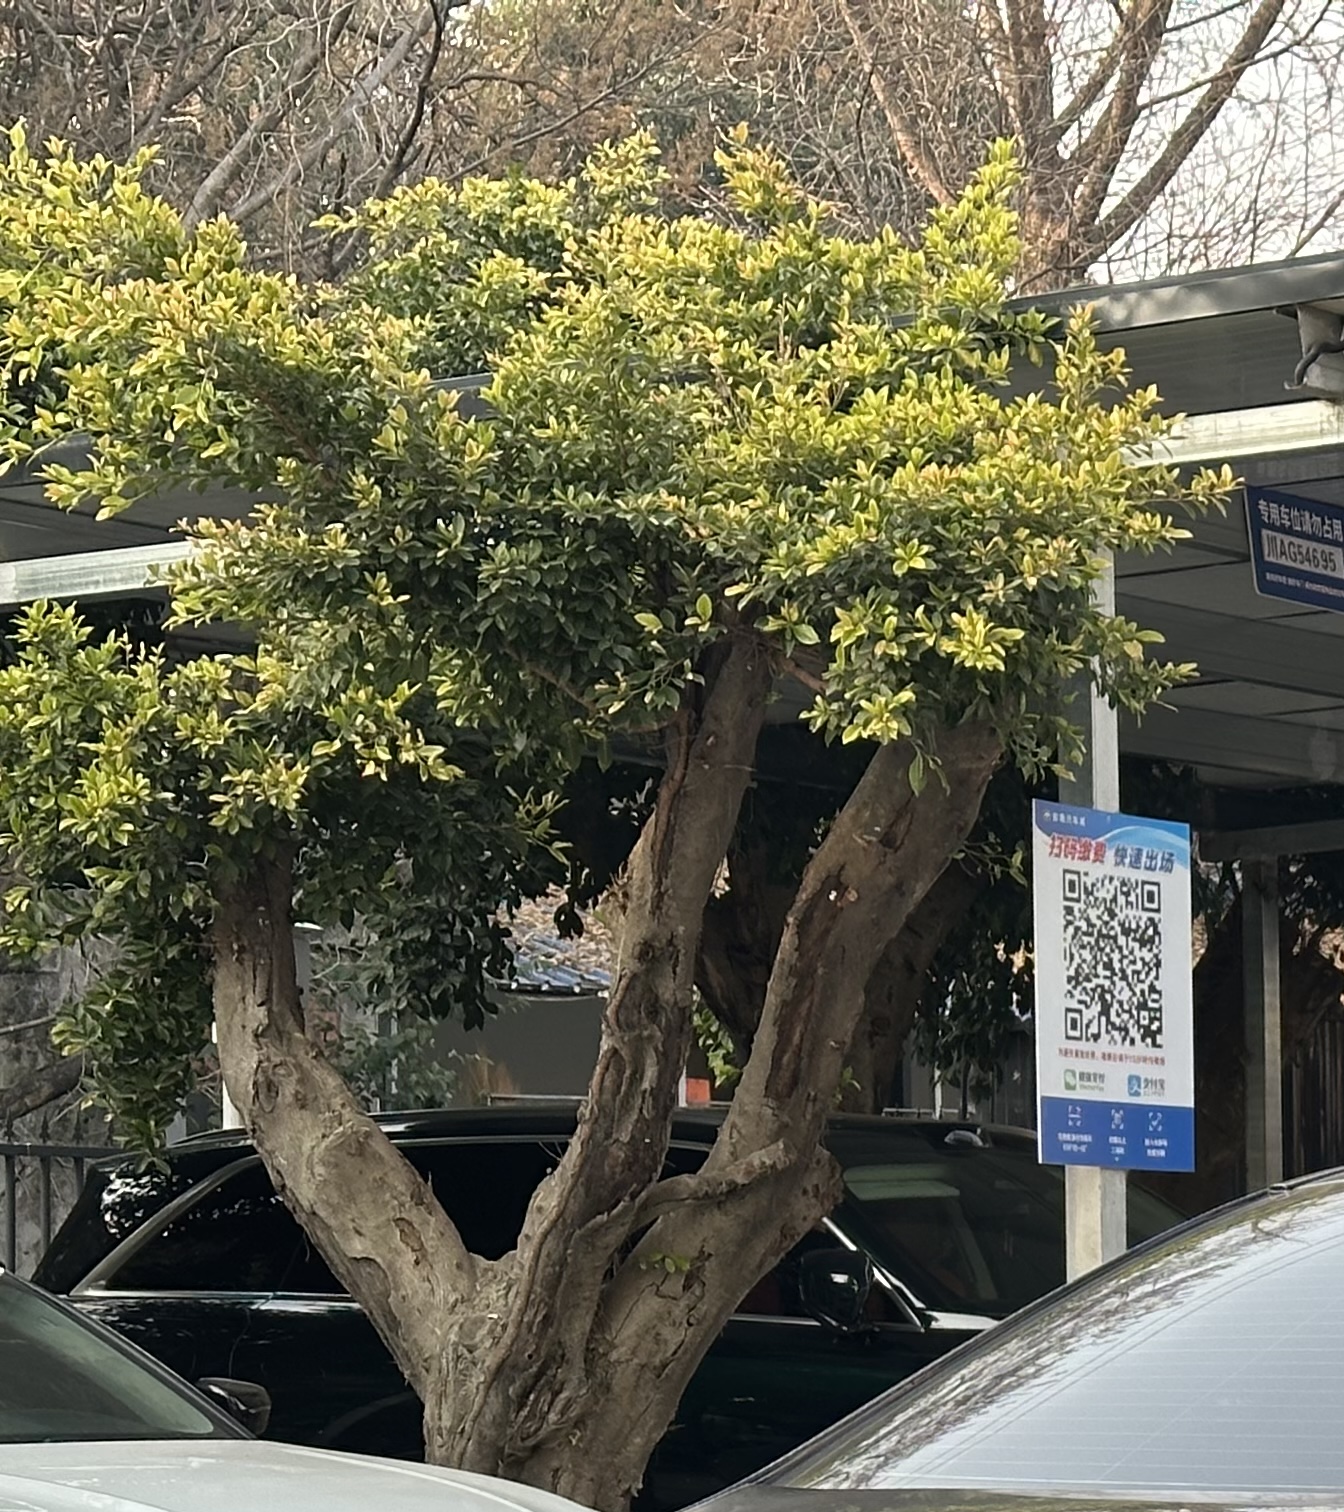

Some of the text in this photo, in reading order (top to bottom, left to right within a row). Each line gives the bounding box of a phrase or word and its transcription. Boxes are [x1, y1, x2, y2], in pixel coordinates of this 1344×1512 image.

[1258, 498, 1344, 542] 专用车位请勿占用
[1266, 534, 1337, 572] 川AG54695
[1049, 832, 1175, 874] 扫码缴费 快速出场
